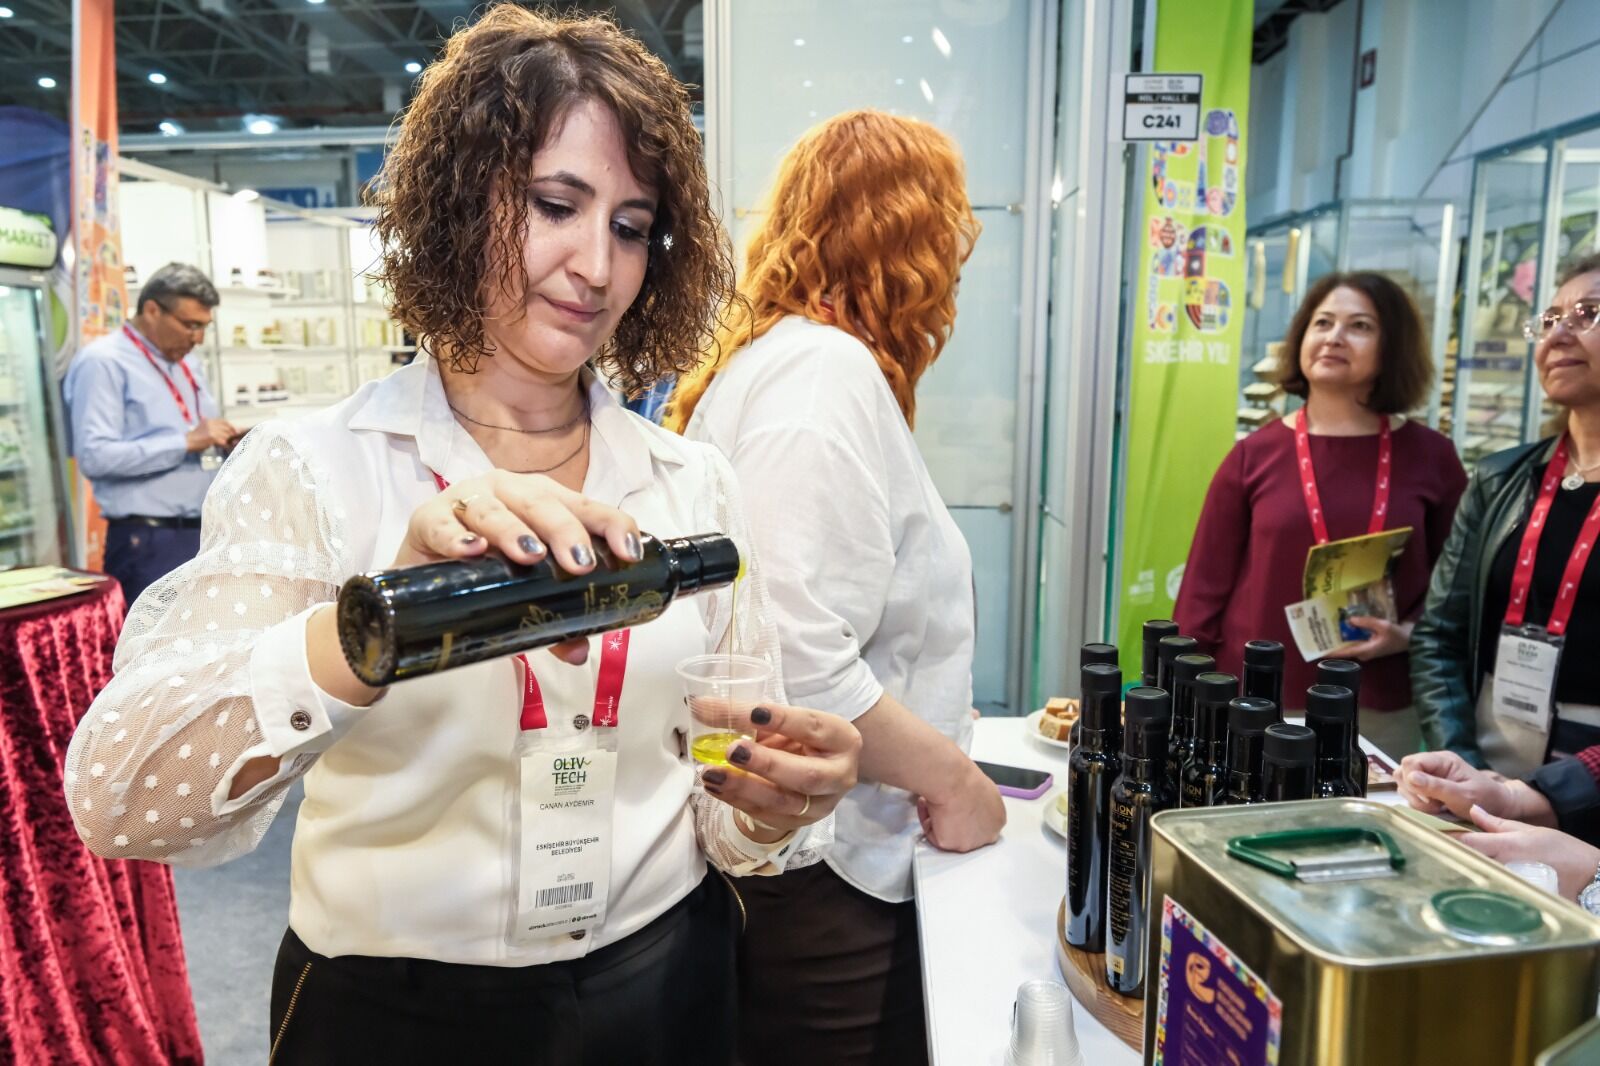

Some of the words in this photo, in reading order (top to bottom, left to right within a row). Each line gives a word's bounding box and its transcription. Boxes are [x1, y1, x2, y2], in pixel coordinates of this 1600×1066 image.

[1142, 114, 1182, 129] C241
[553, 757, 585, 771] OLIV
[551, 770, 586, 785] TECH
[539, 802, 563, 811] CANAN
